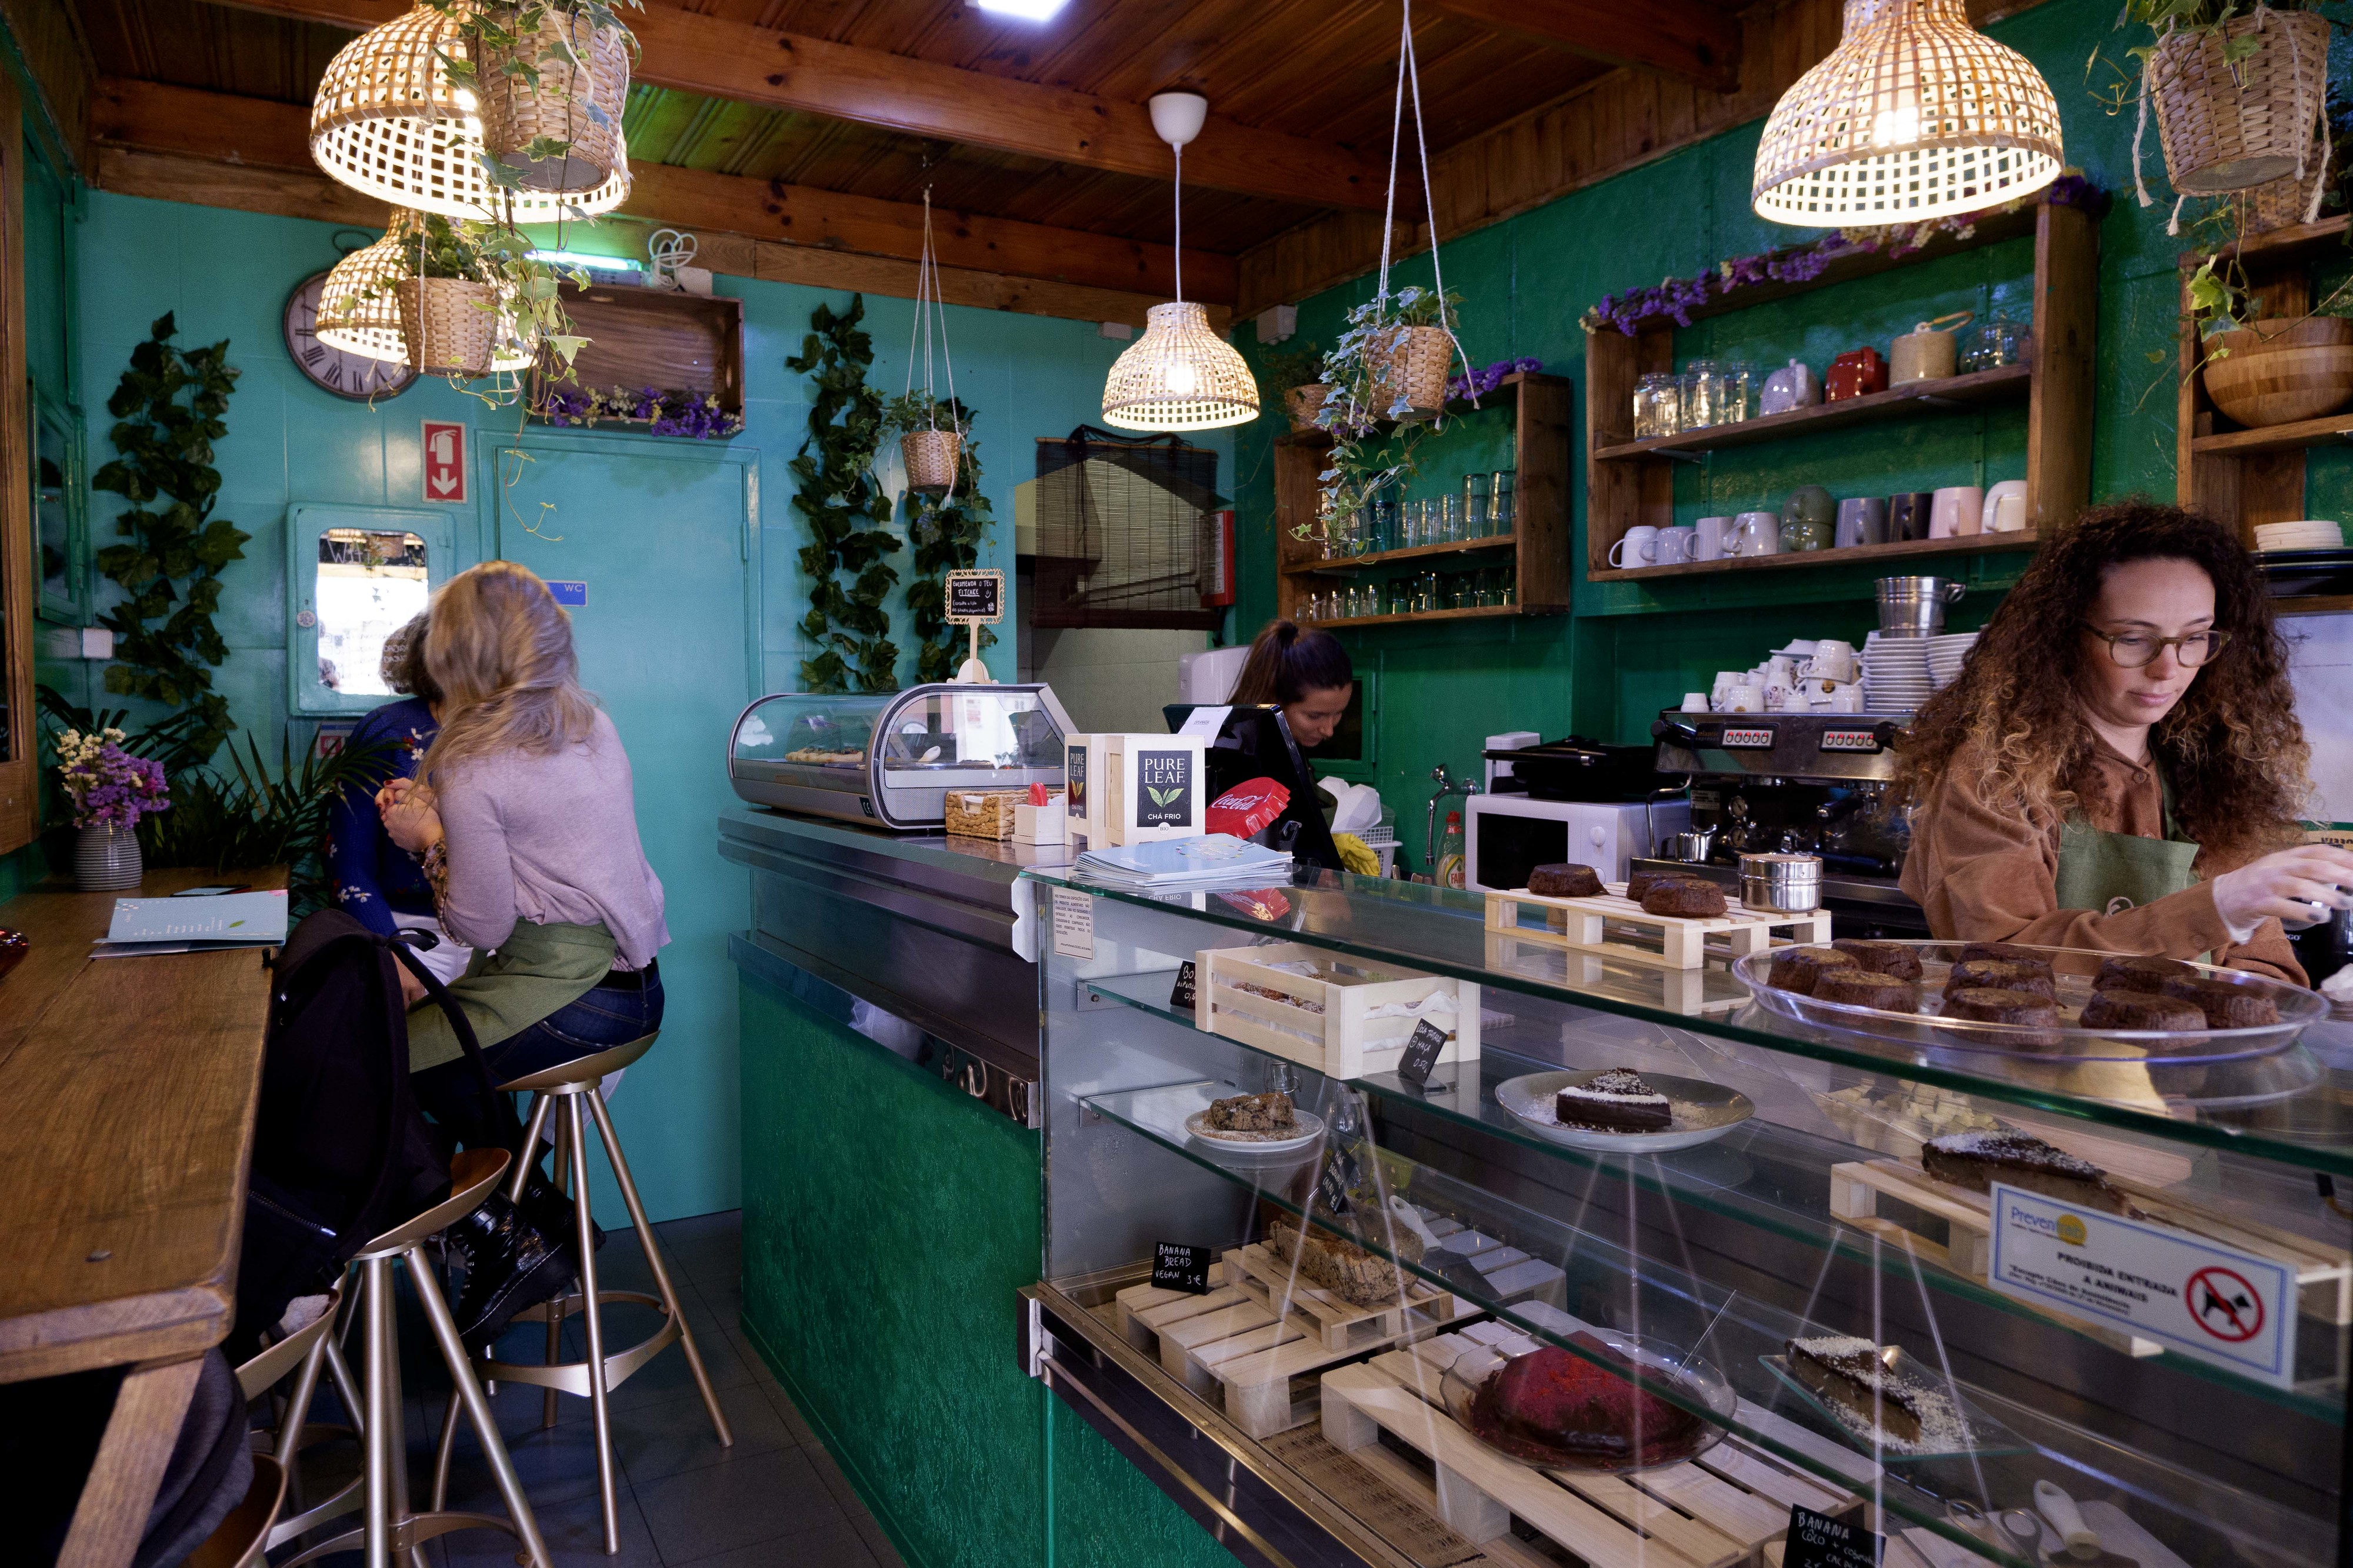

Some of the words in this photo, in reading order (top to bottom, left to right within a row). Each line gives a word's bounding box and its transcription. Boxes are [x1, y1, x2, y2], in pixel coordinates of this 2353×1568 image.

[1071, 753, 1084, 765] PURE
[1145, 758, 1185, 770] PURE
[1071, 766, 1084, 777] LEAF
[1145, 772, 1185, 783] LEAF
[1182, 965, 1195, 980] BO
[1159, 1244, 1190, 1256] BANANA
[1165, 1256, 1191, 1267] BREAD
[1155, 1270, 1179, 1279] VEGAN
[2057, 1251, 2114, 1277] PROIBIDA
[2118, 1270, 2178, 1297] ENTRADA
[2083, 1275, 2091, 1285] A
[2095, 1279, 2148, 1303] ANIMAIS
[1798, 1512, 1849, 1540] BANANA
